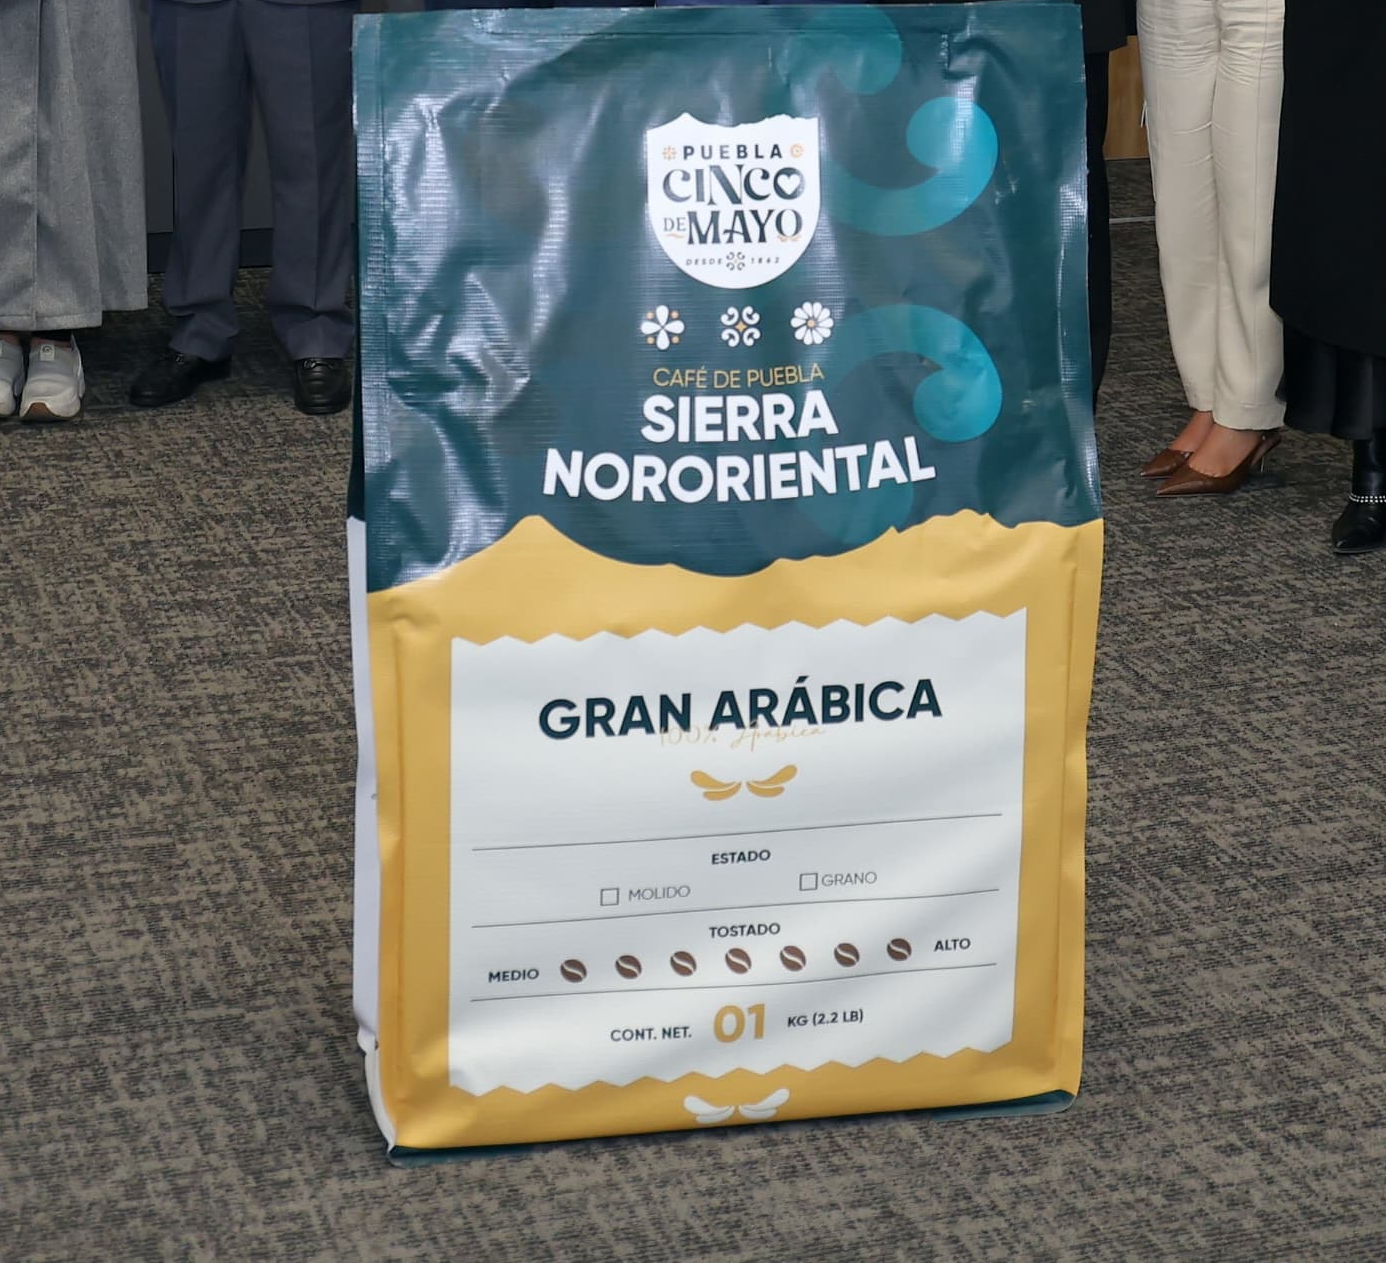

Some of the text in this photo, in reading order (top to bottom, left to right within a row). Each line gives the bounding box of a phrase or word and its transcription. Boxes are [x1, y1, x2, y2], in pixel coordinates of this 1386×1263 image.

[683, 143, 783, 160] PUEBLA
[662, 164, 806, 206] CINCO
[663, 209, 803, 245] DE MAYO
[685, 256, 780, 266] DESDE 1862
[652, 362, 825, 389] CAFÉ DE PUEBLA
[640, 390, 839, 443] SIERRA
[542, 435, 937, 504] NORORIENTAL
[539, 675, 943, 740] GRAN ARÁBICA
[711, 849, 771, 865] ESTADO
[821, 871, 877, 887] GRANO
[628, 885, 691, 902] MOLIDO
[709, 922, 781, 939] TOSTADO
[933, 937, 971, 952] ALTO
[488, 968, 539, 983] MEDIO
[610, 1003, 864, 1043] CONT. NET. 01 KG (2.2 LB)
